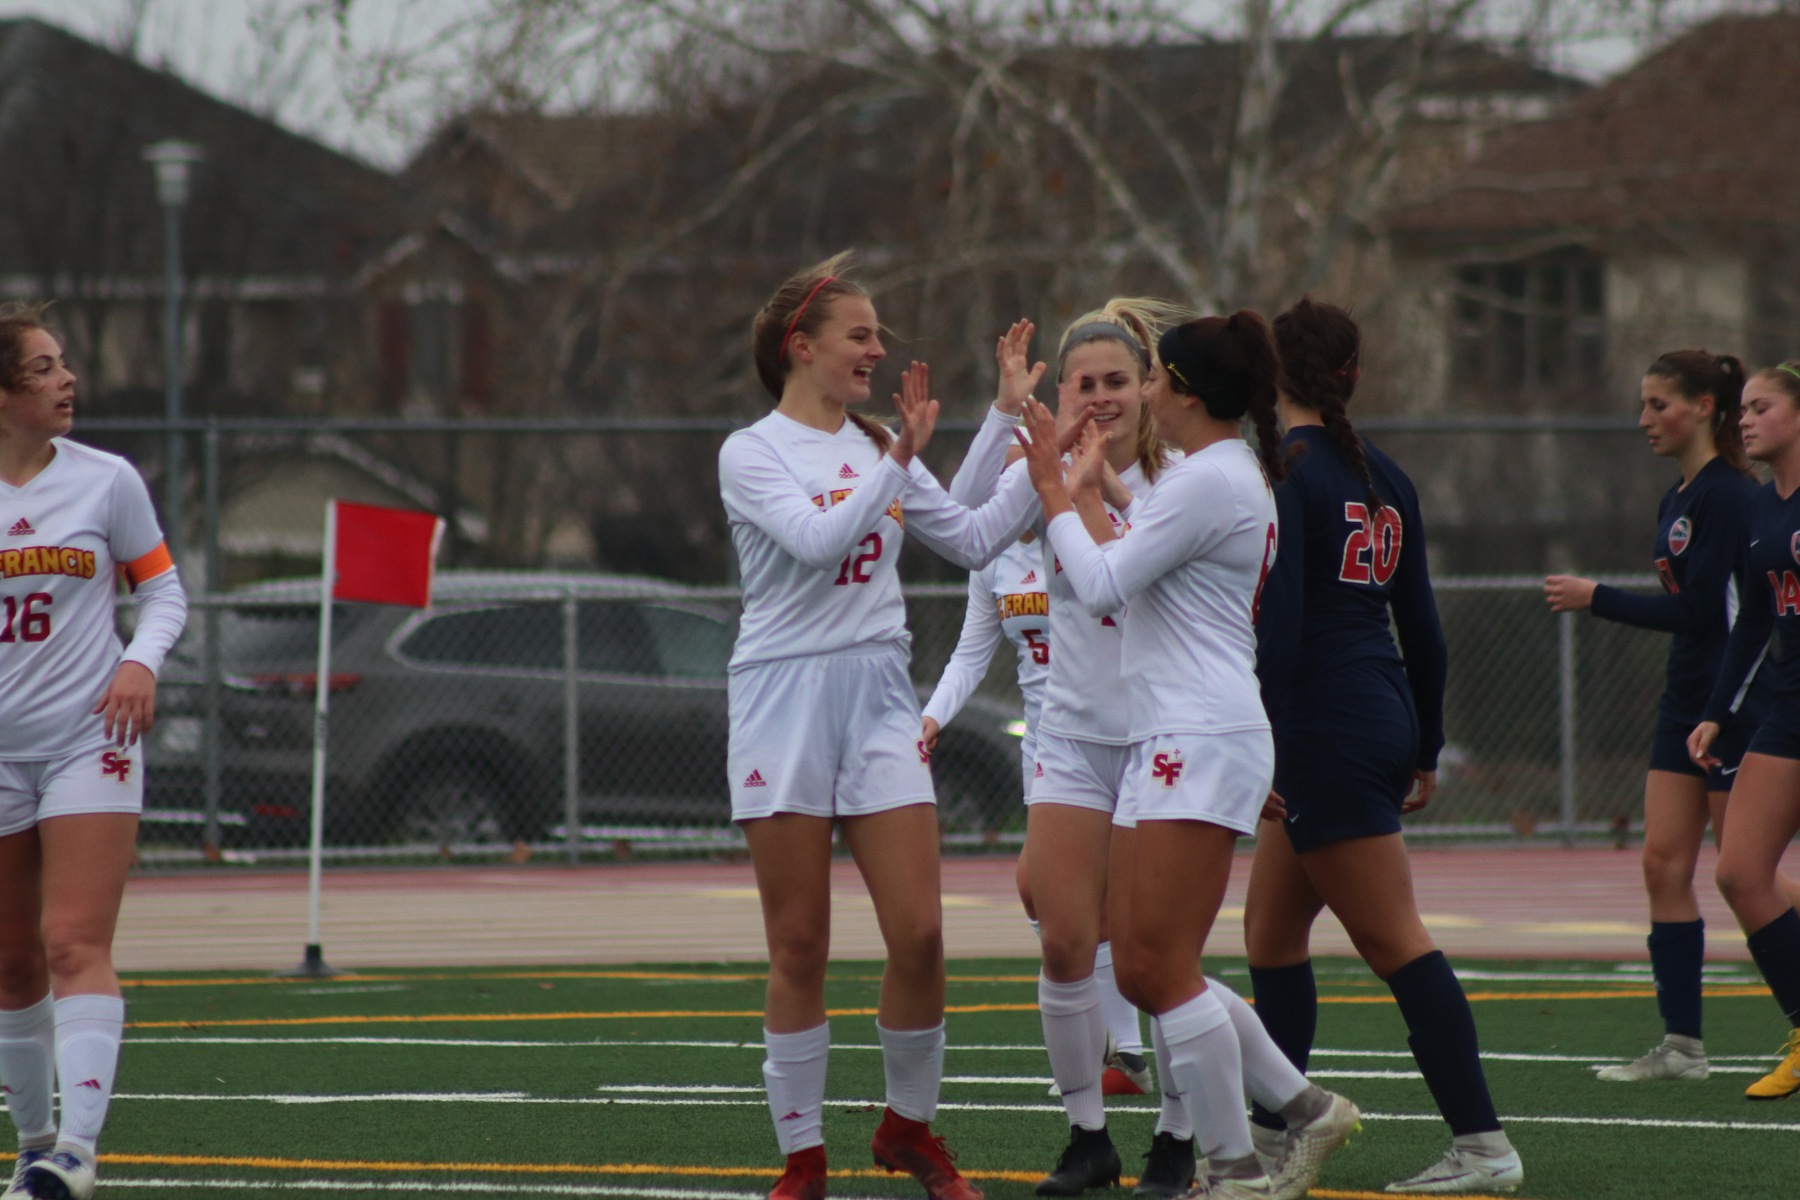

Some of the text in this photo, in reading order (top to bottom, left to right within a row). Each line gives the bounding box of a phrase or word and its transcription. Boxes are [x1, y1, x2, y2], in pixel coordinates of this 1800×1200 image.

[0, 546, 95, 579] RANCIS
[833, 531, 883, 586] 12
[1339, 501, 1402, 586] 20
[0, 592, 53, 642] 16
[1021, 628, 1050, 666] 5
[1152, 753, 1183, 786] SF
